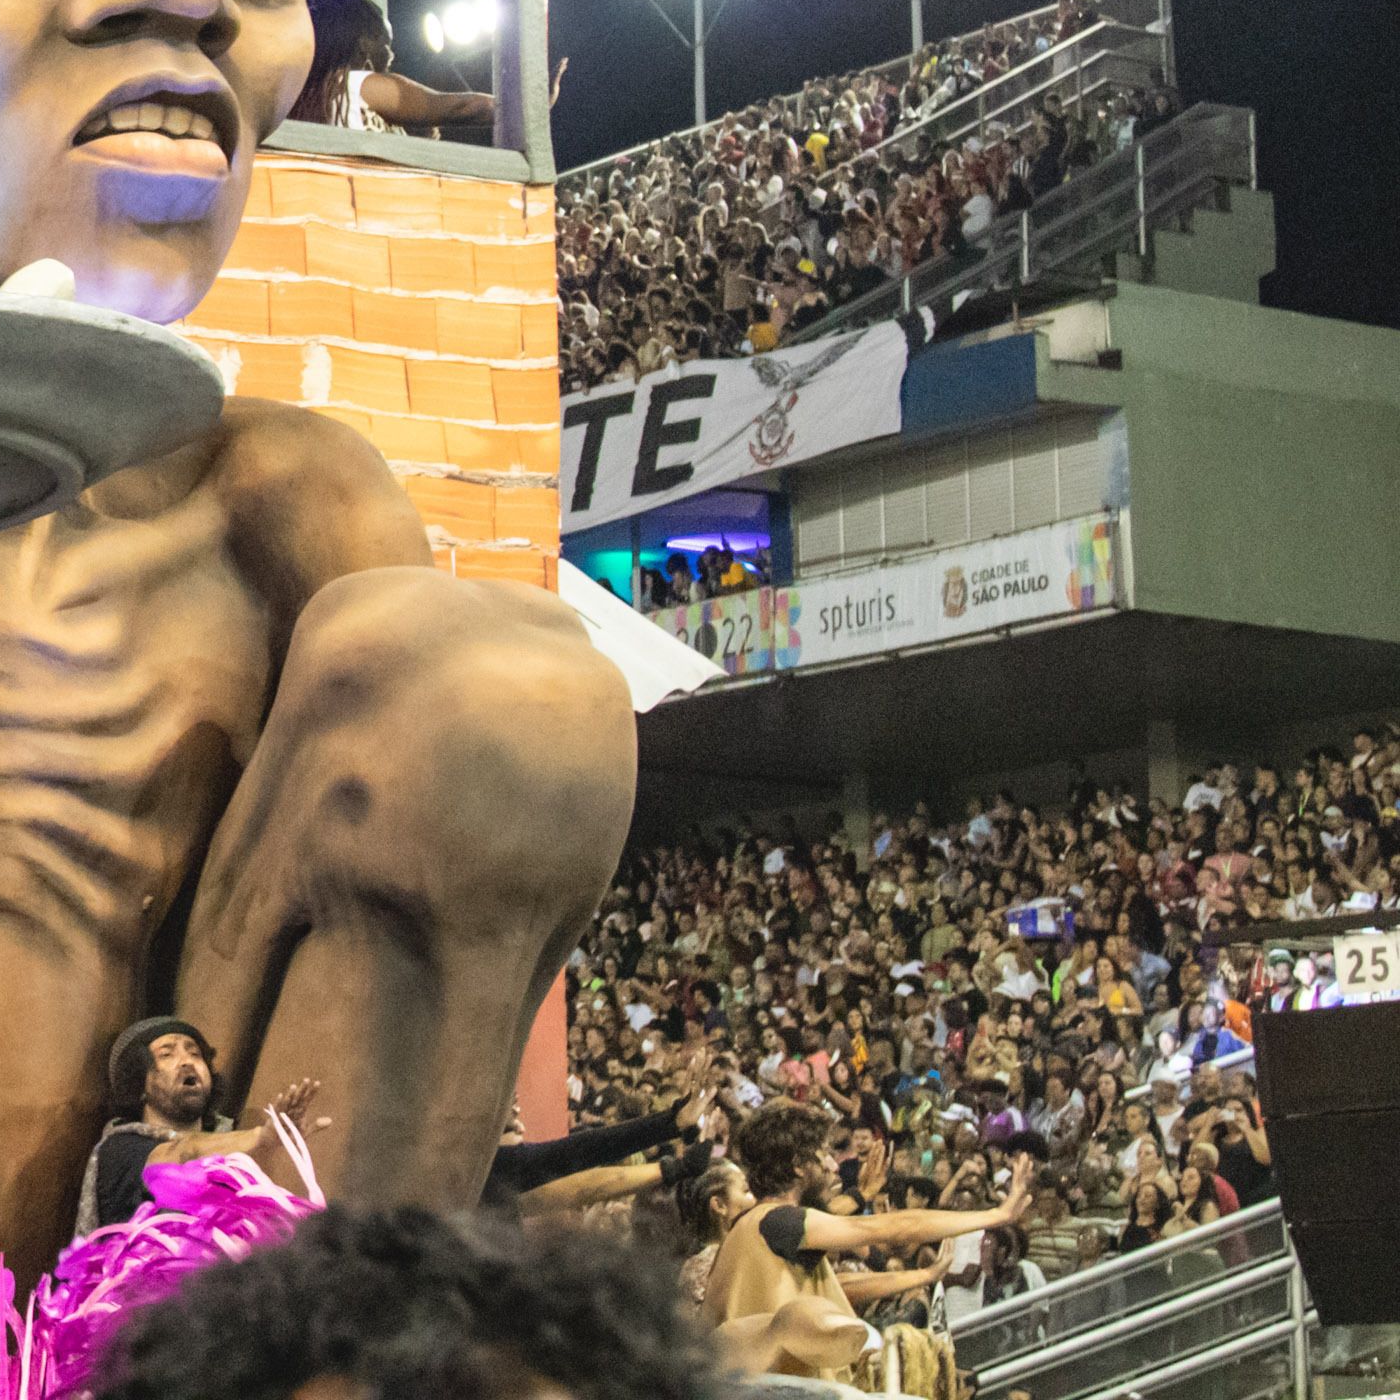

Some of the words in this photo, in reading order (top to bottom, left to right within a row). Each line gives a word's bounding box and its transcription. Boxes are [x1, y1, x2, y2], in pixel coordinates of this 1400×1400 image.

[563, 374, 717, 512] TE
[971, 562, 1011, 585] CIDADE
[1015, 559, 1029, 574] DE
[1004, 574, 1049, 598] PAULO
[819, 587, 896, 641] spturis
[1346, 946, 1389, 984] 25
